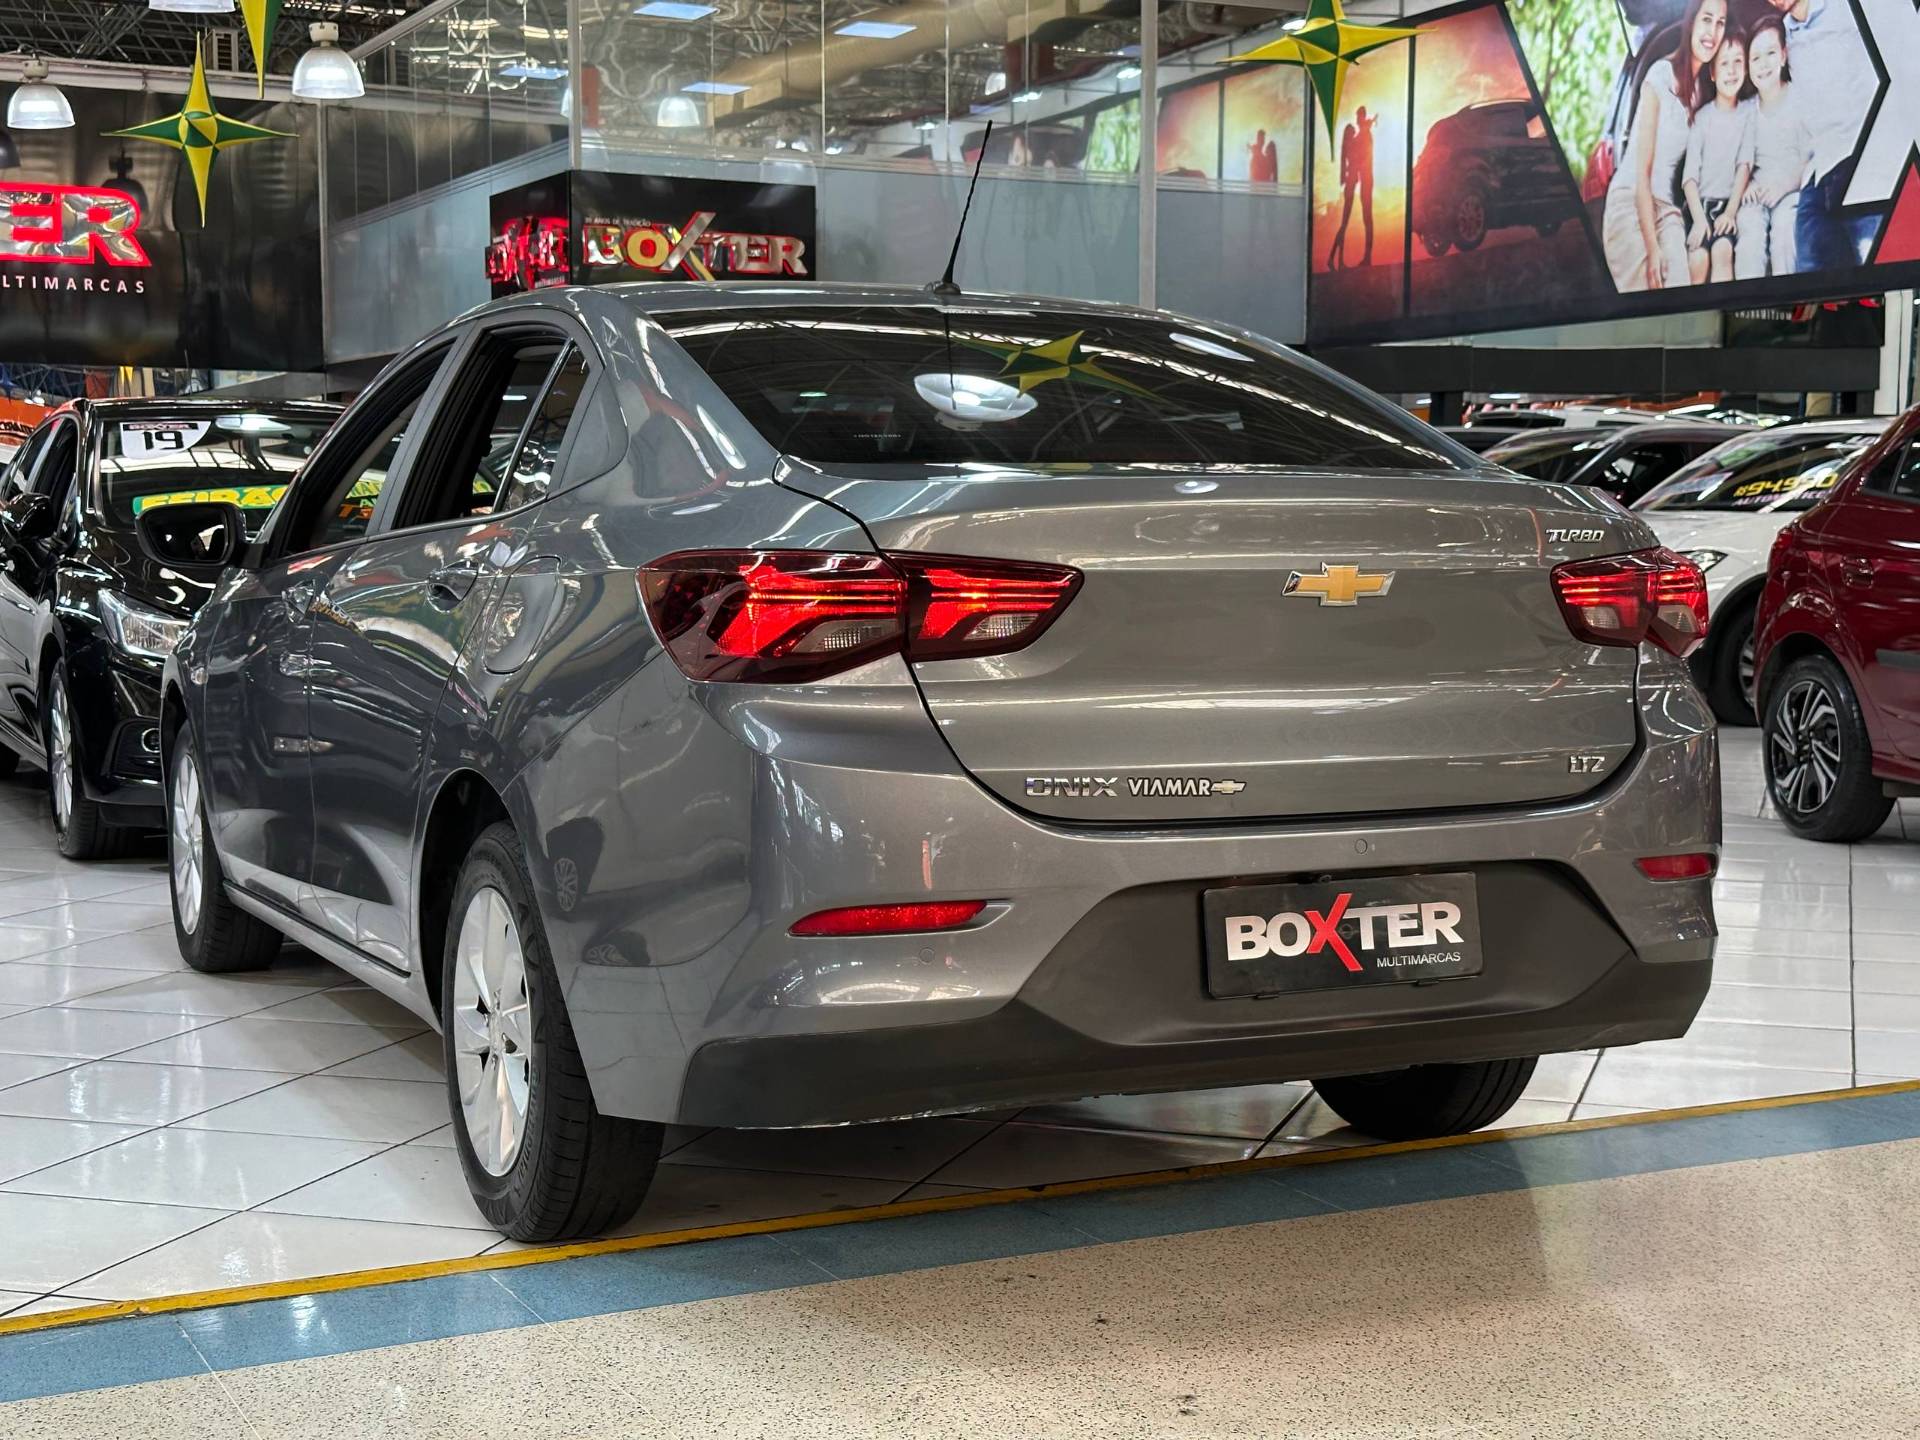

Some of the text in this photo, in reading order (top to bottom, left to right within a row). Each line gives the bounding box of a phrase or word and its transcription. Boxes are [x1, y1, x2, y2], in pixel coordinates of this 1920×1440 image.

[582, 211, 808, 281] BOXTER
[143, 431, 185, 450] 19
[1546, 529, 1605, 543] TURBO
[1570, 756, 1605, 773] LTZ
[1025, 777, 1211, 797] ONIX VIAMAR
[1225, 893, 1464, 971] BOXTER
[1376, 952, 1461, 968] MULTIMARCAS
